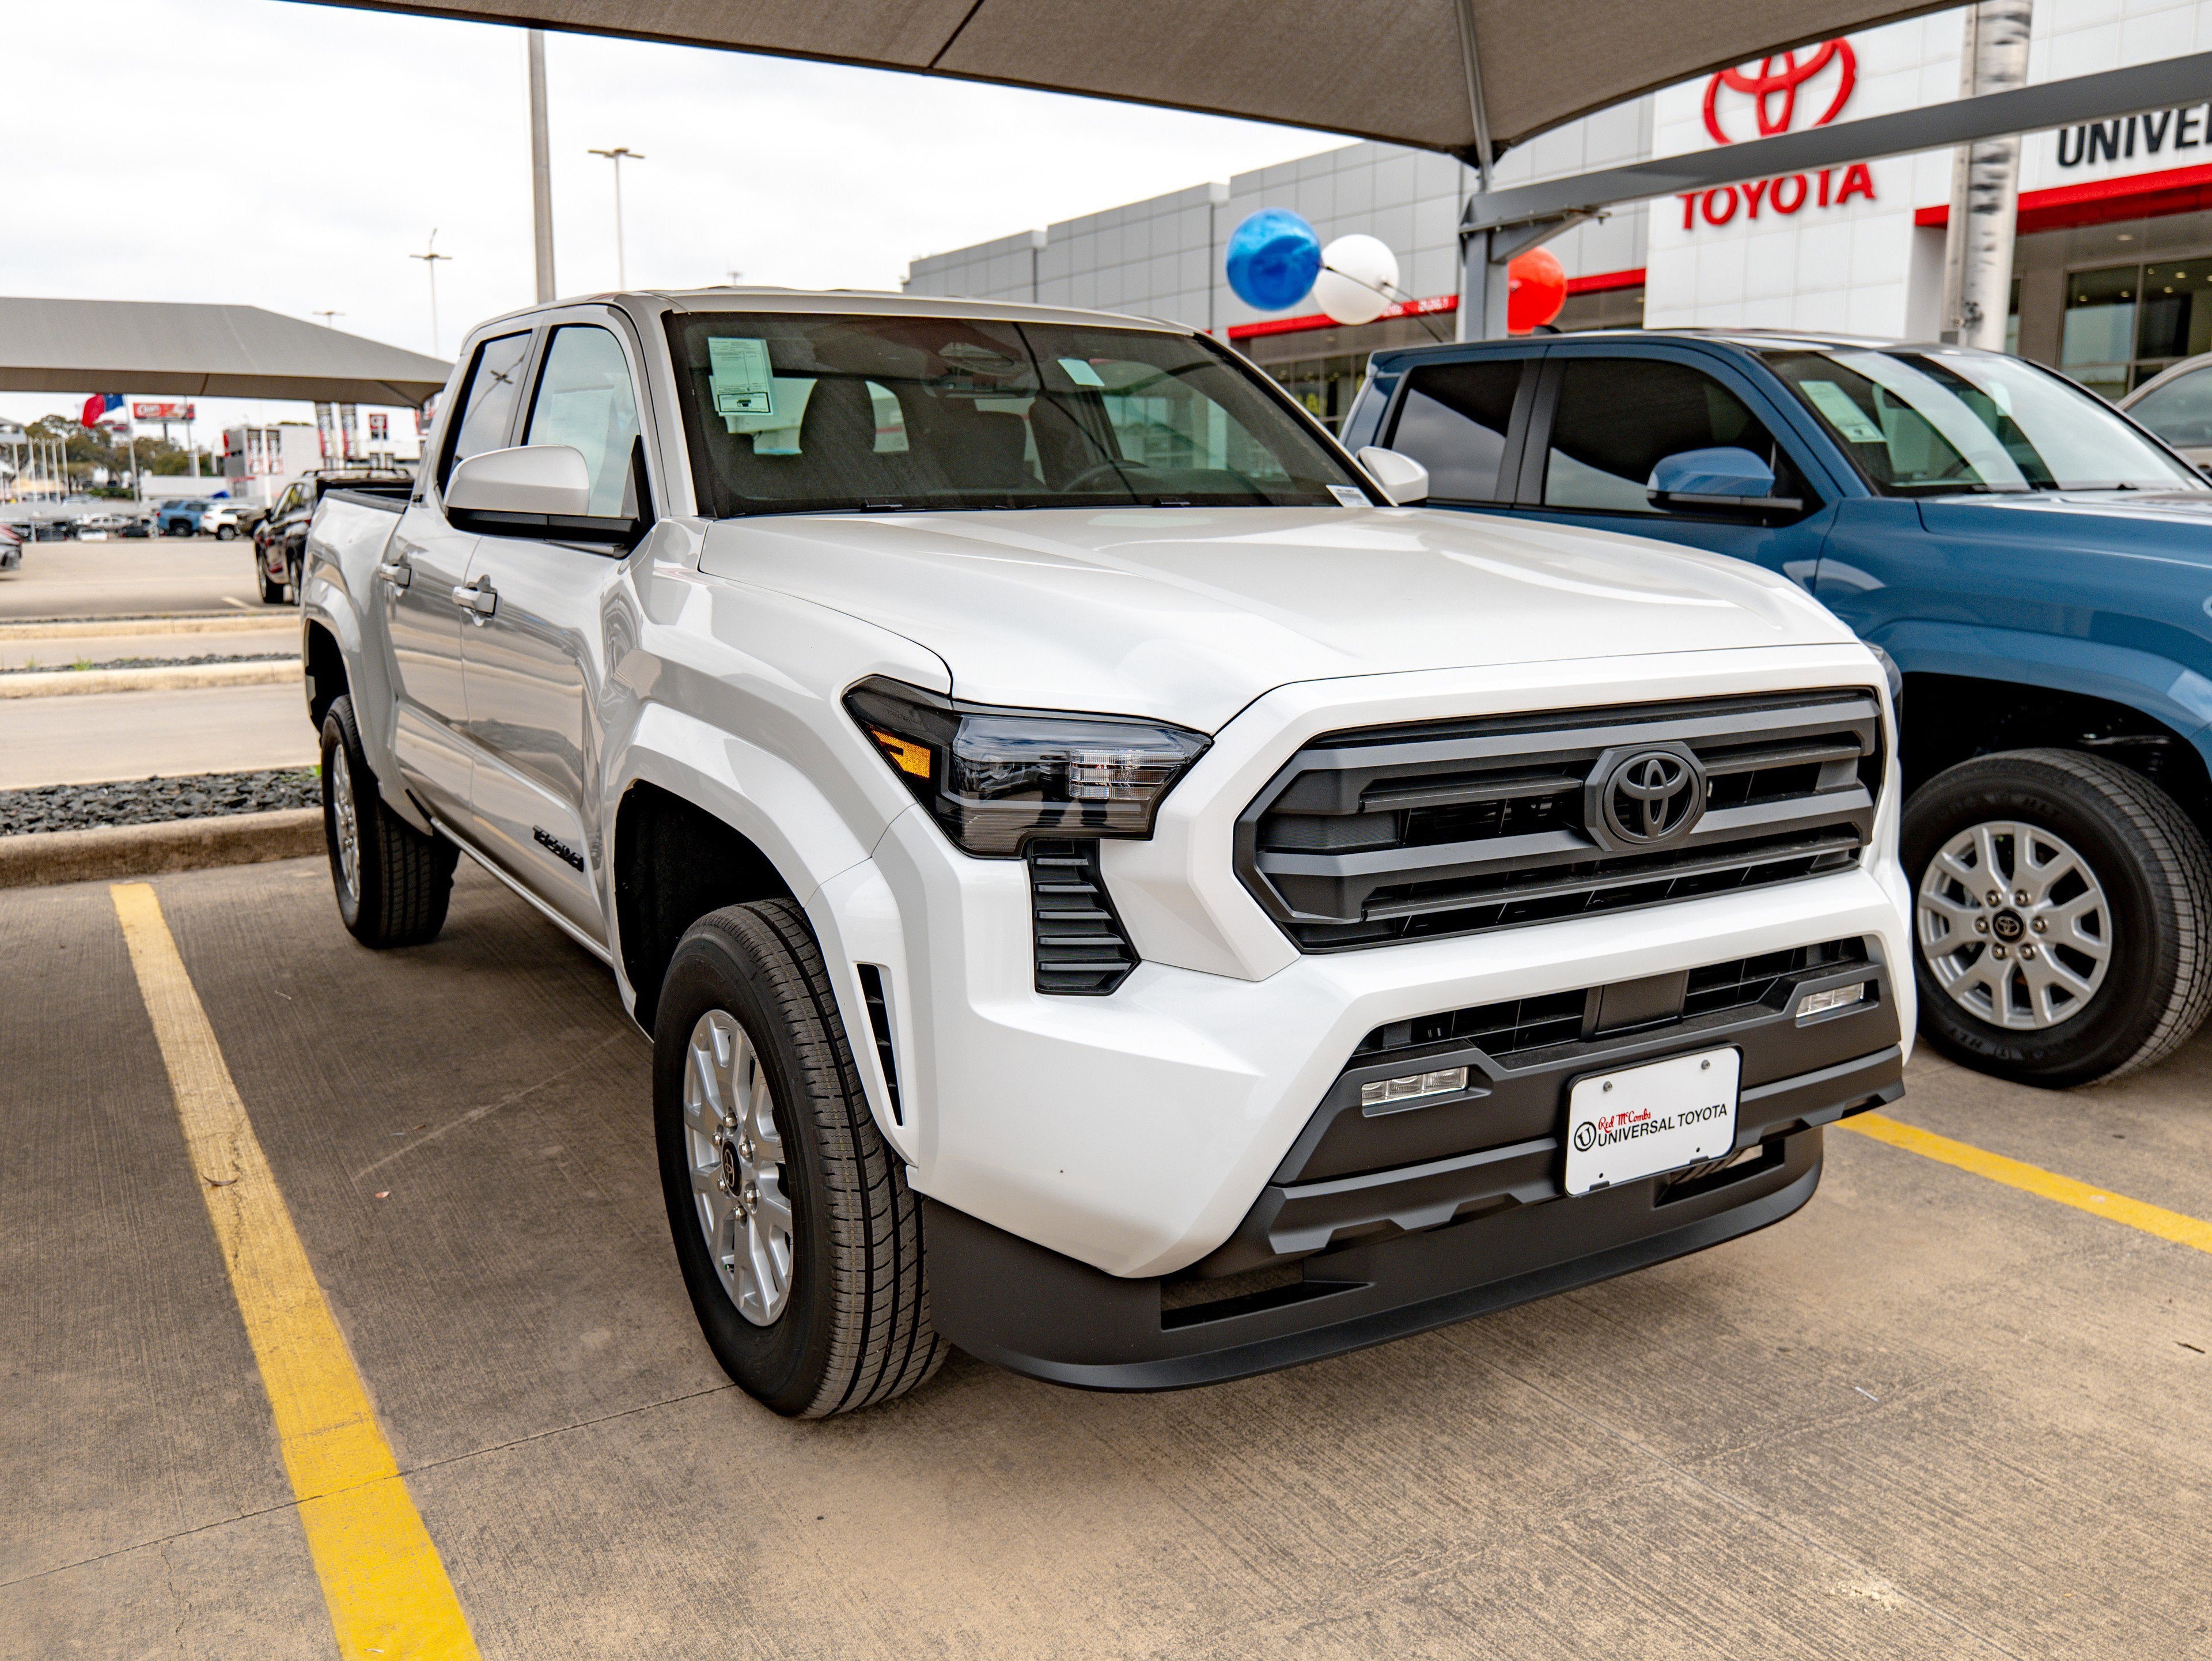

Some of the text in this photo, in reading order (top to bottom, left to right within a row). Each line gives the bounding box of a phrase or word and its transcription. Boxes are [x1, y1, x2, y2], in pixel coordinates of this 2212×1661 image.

[2058, 103, 2212, 167] UNIVE
[1676, 162, 1876, 229] TOYOTA
[1598, 1108, 1651, 1133] Red McCombs
[1598, 1103, 1727, 1147] UNIVERSAL TOYOTA
